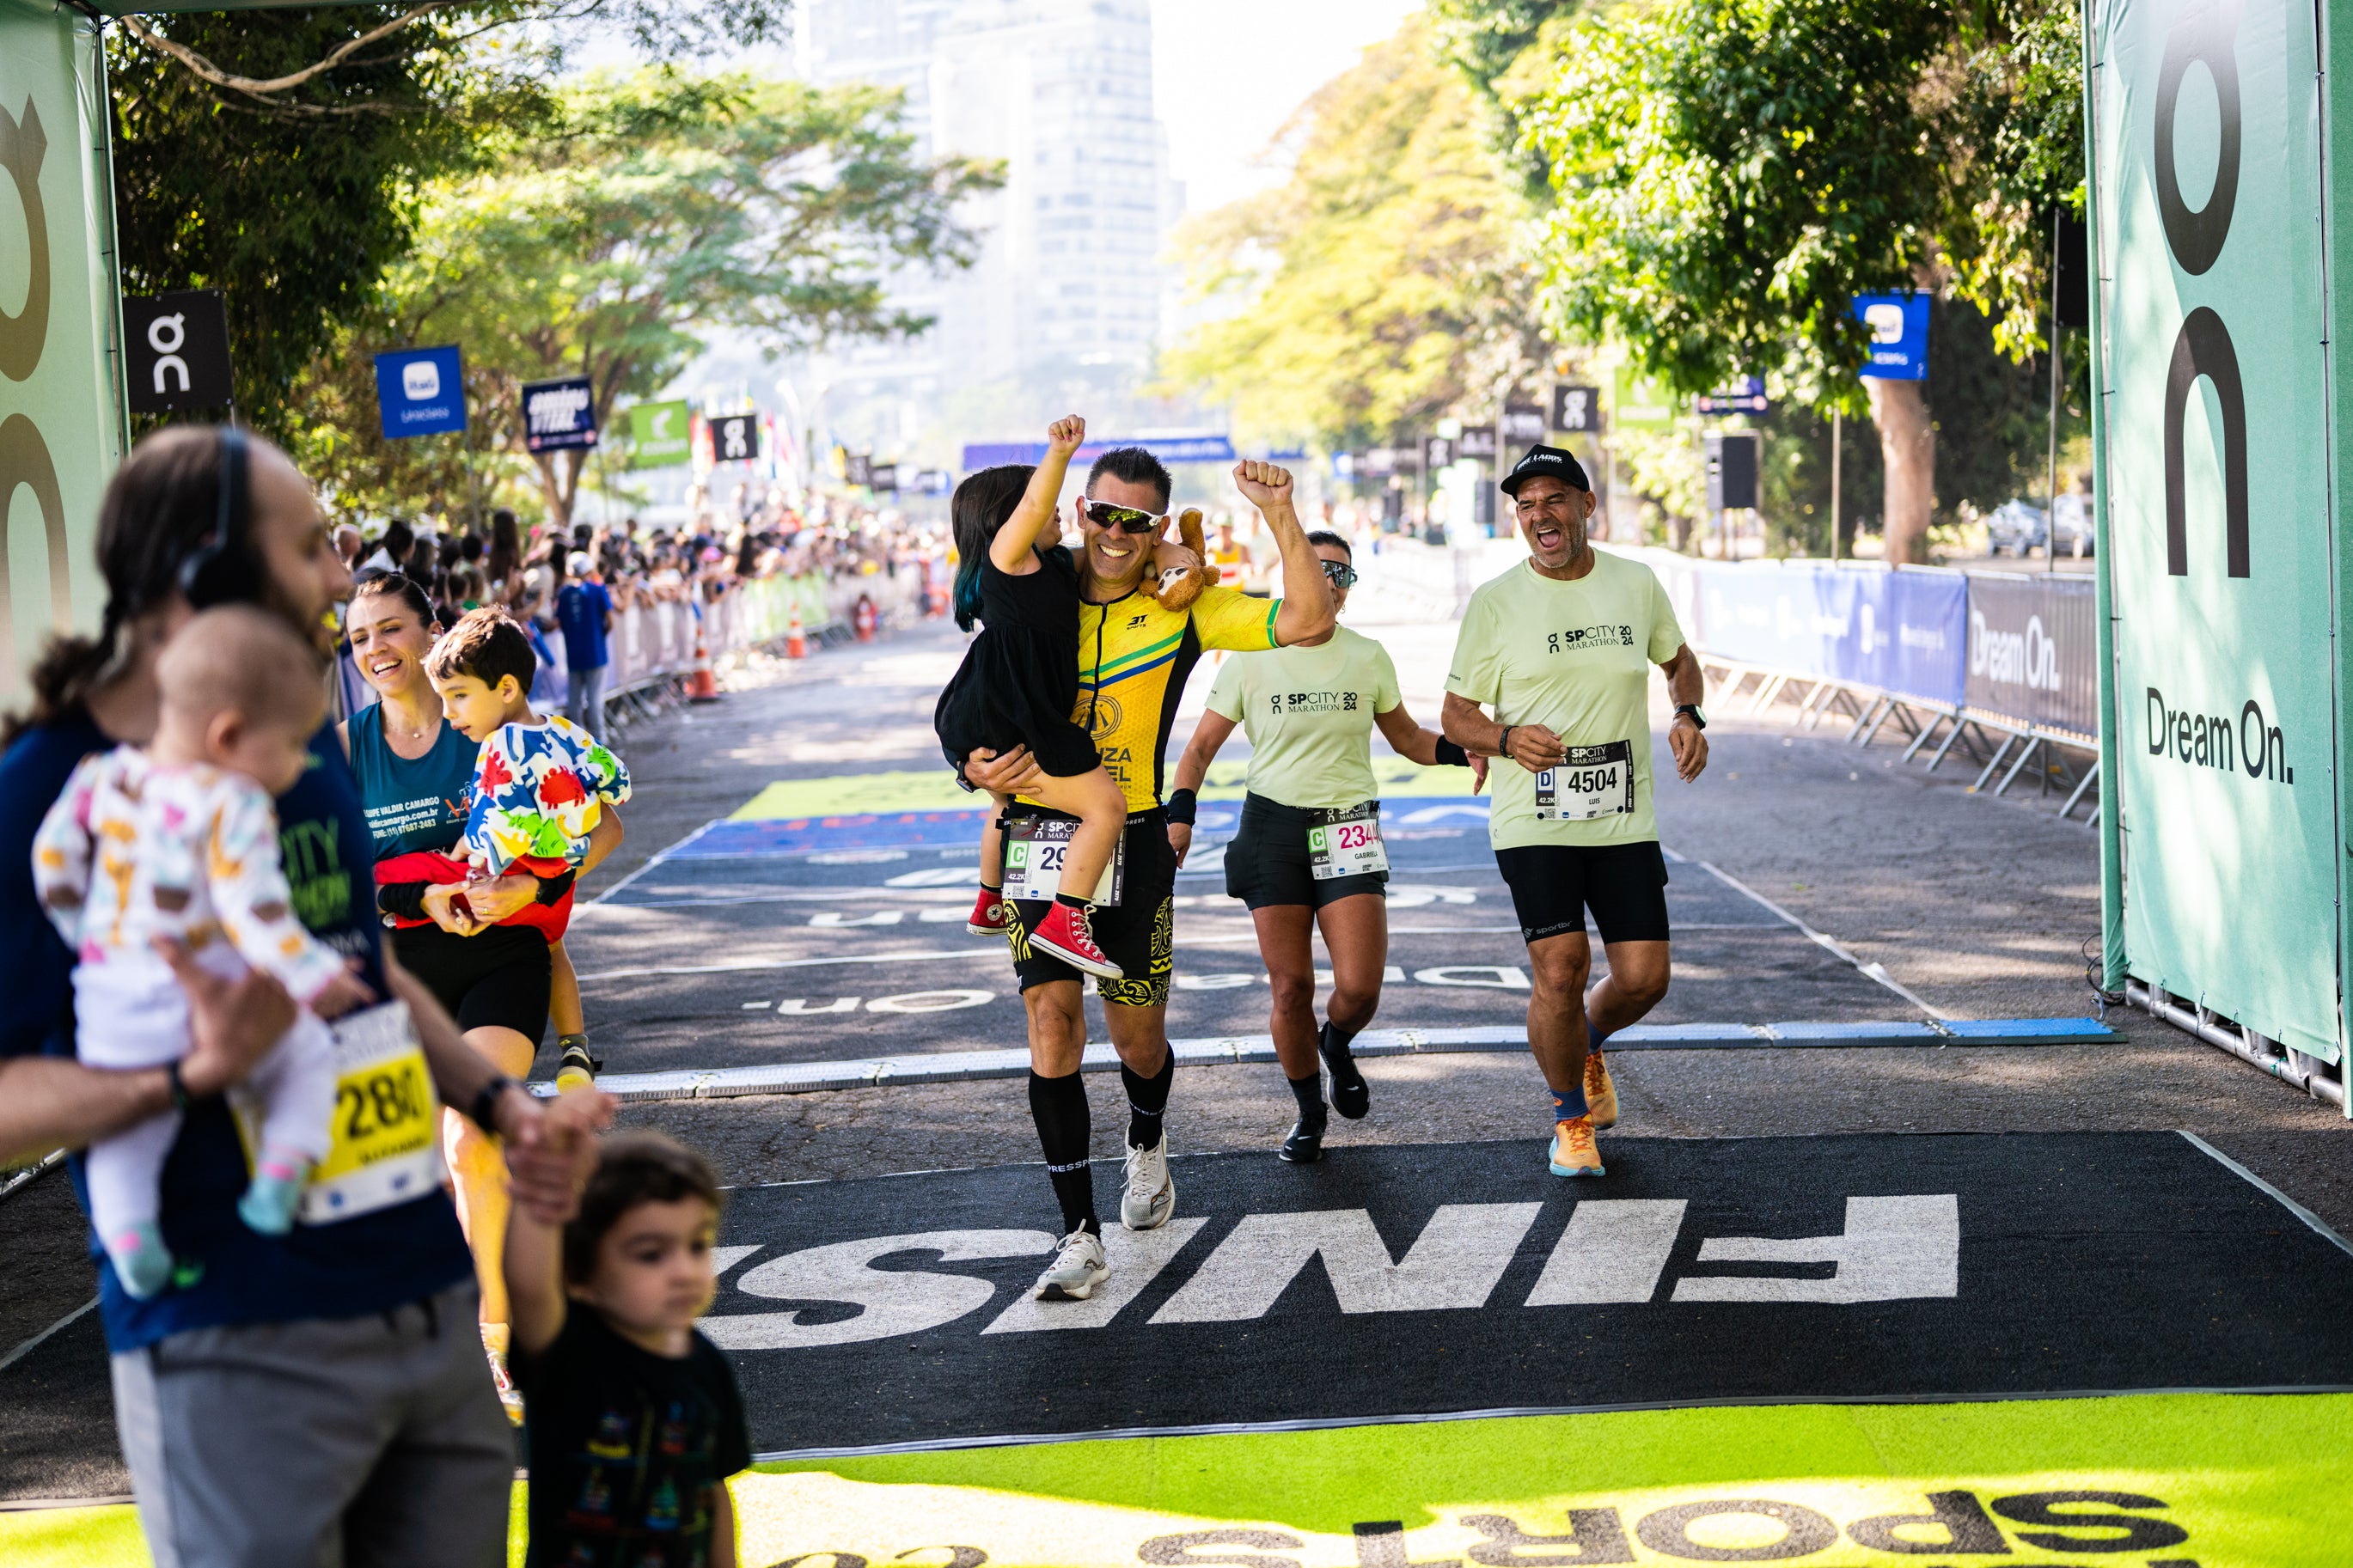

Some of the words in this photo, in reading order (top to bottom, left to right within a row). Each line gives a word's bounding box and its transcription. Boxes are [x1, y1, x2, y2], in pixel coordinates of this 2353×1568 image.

[1565, 625, 1616, 643] SPCITY
[1567, 638, 1619, 650] MARATHON
[1971, 609, 2025, 685] Dream
[2026, 614, 2060, 692] On.
[1288, 692, 1339, 705] SPCITY
[1288, 704, 1340, 713] MARATHON
[2147, 686, 2234, 772] Dream
[2240, 699, 2294, 784] On.
[1571, 746, 1606, 758] SPCITY
[1572, 755, 1607, 764] MARATHON
[1540, 772, 1551, 787] D
[1568, 767, 1617, 793] 4504
[380, 803, 404, 815] VALDIR
[405, 796, 440, 810] CAMARGO
[1312, 832, 1323, 847] C
[1013, 846, 1024, 863] C
[698, 1194, 1959, 1350] FINIS
